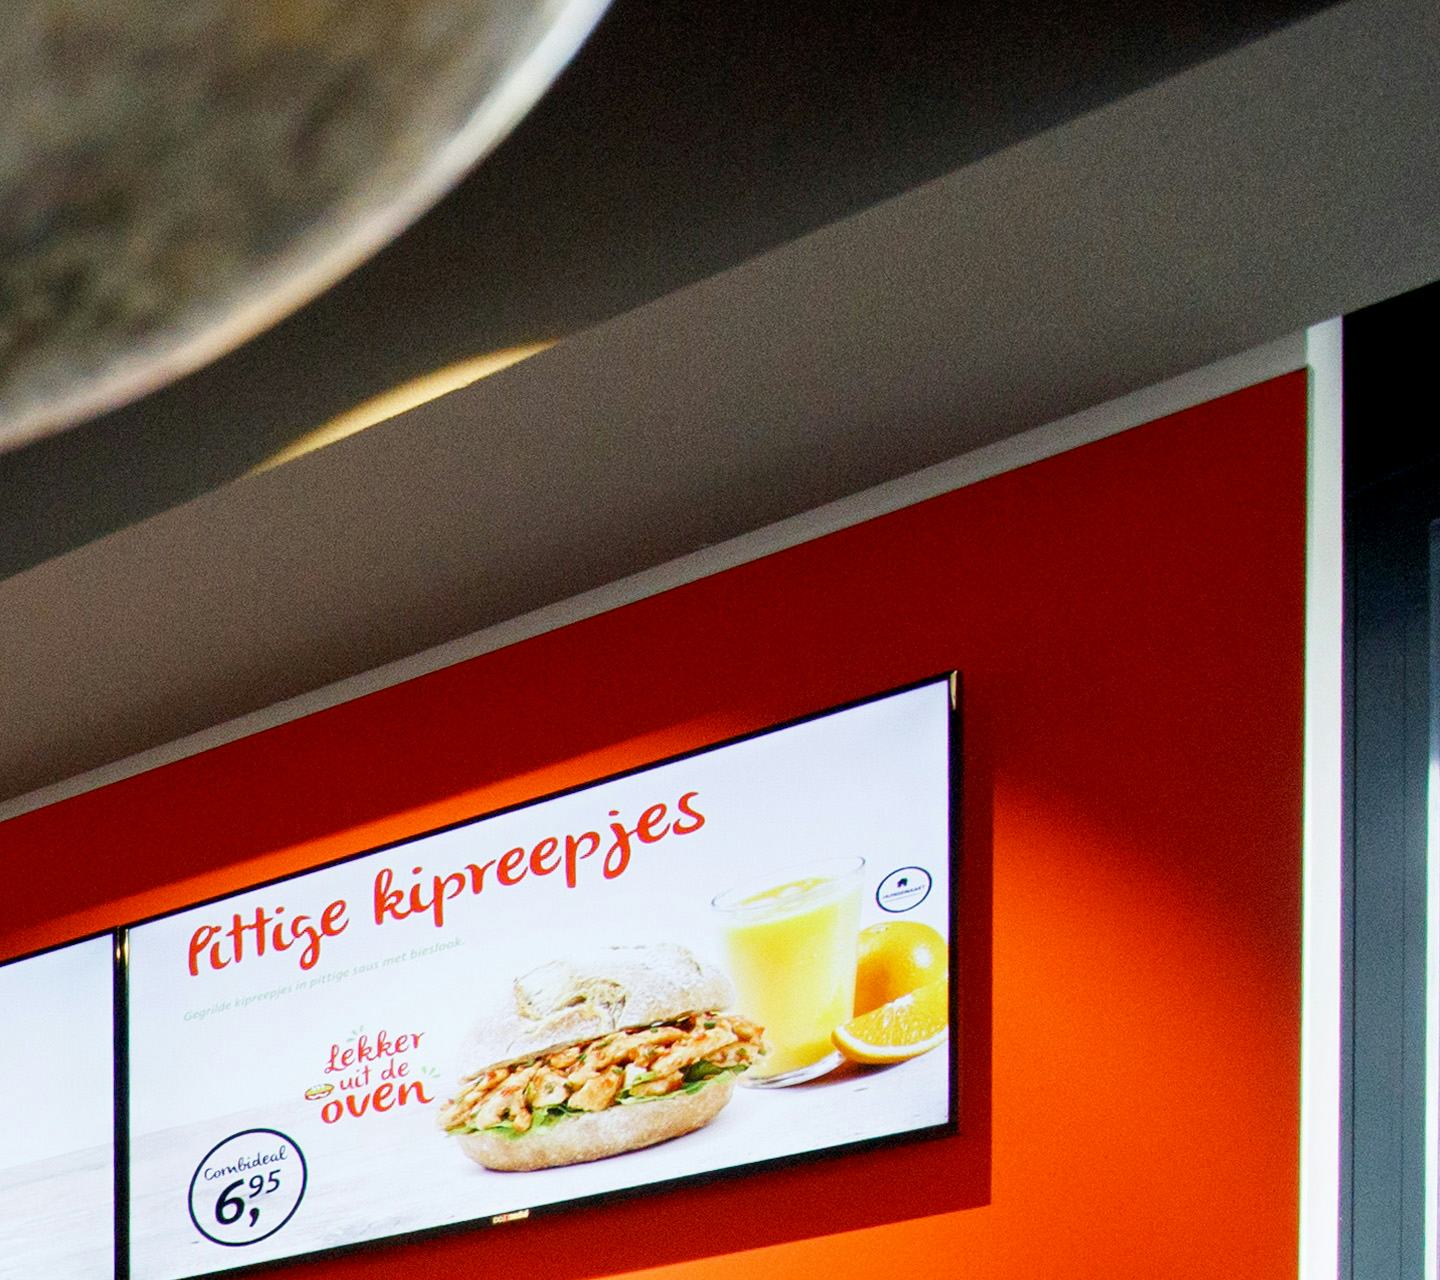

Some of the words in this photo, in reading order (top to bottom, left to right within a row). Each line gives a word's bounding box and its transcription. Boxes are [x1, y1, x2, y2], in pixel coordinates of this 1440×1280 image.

[188, 898, 349, 977] Pittige
[373, 791, 706, 928] kipreepjes
[184, 1001, 231, 1022] Gegrilde
[234, 984, 292, 1006] kipreepjes
[296, 980, 307, 992] in
[309, 969, 349, 990] pittige
[353, 961, 379, 975] saus
[383, 952, 407, 969] met
[409, 937, 465, 961] bieslook.
[324, 1030, 426, 1073] Lekker
[340, 1066, 371, 1089] uit
[380, 1059, 410, 1081] de
[321, 1080, 435, 1124] oven
[204, 1145, 288, 1181] Combideal
